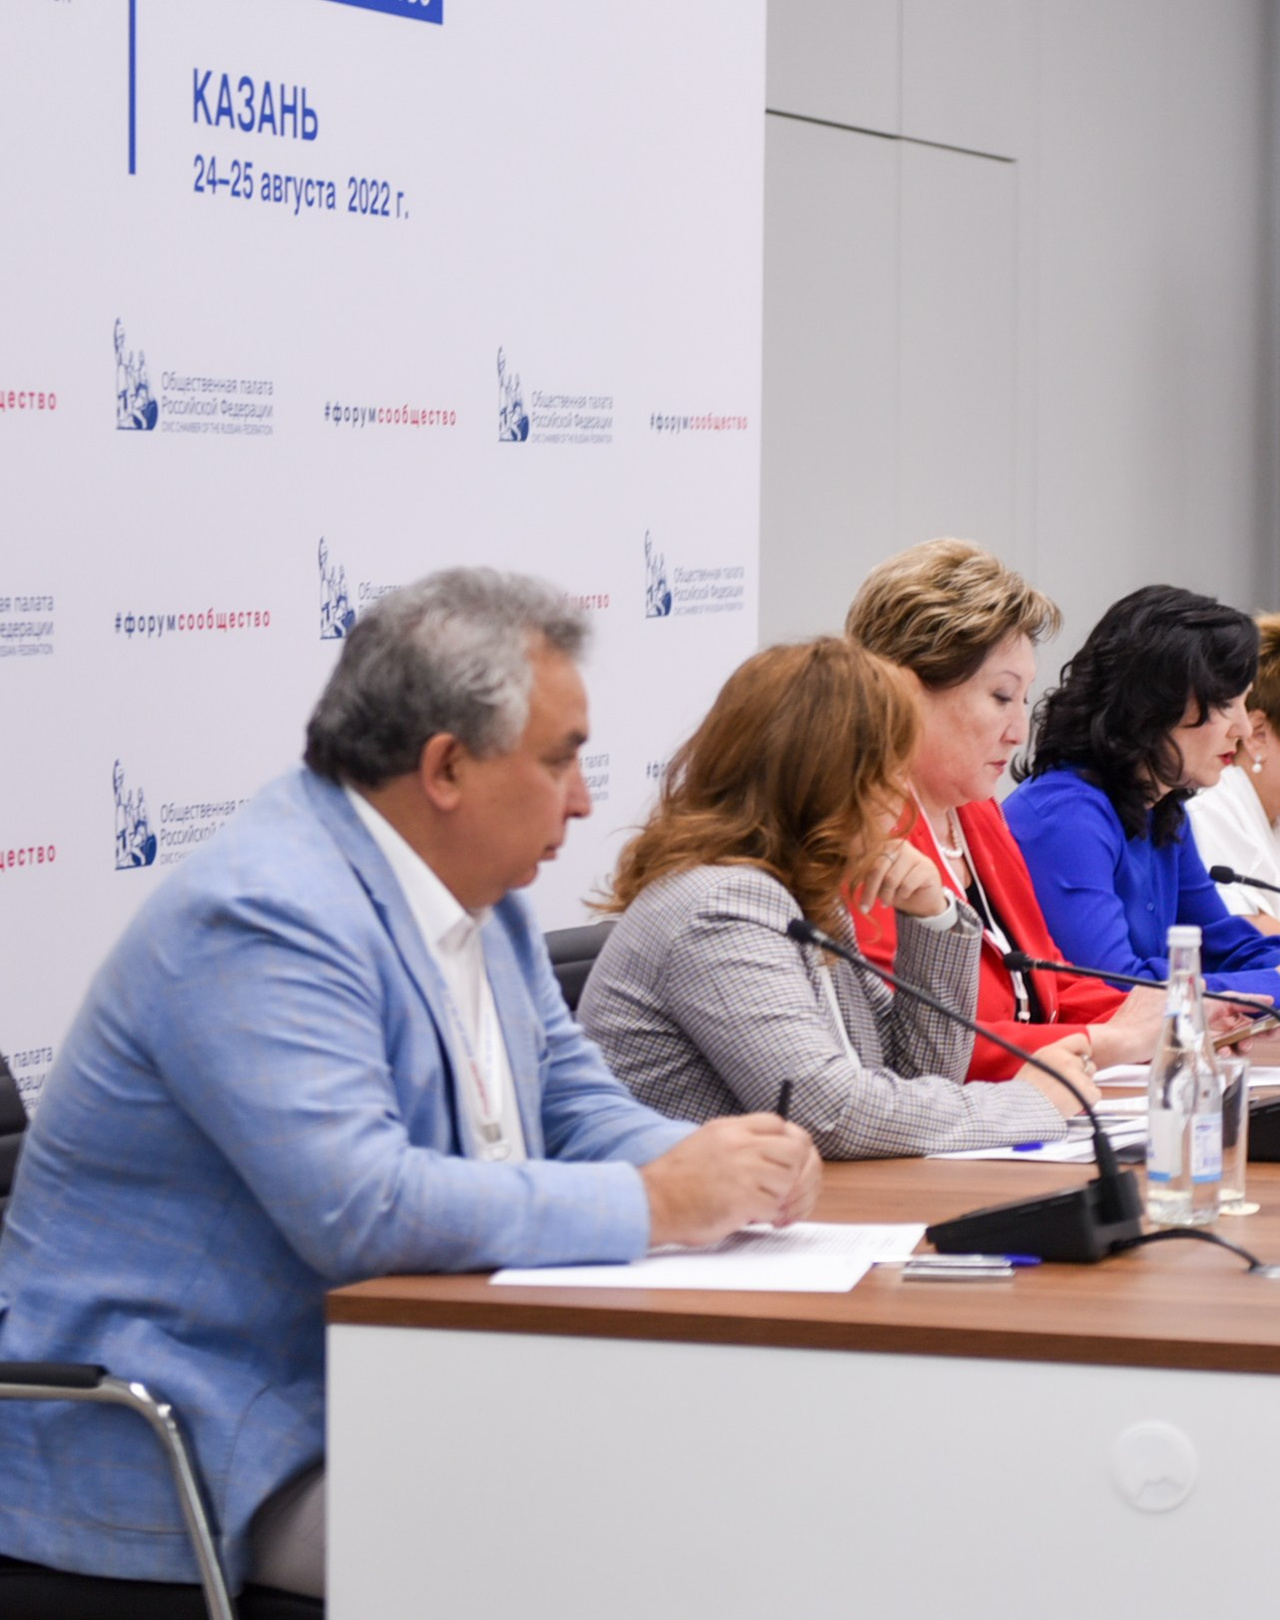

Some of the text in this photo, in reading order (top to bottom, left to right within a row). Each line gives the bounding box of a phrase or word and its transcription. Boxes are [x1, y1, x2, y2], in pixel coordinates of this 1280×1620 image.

[193, 68, 319, 141] КАЗАНЬ
[260, 172, 337, 216] августа
[347, 176, 391, 217] 2022
[396, 191, 410, 220] г.
[161, 371, 273, 396] Общественная палата
[161, 395, 273, 421] Российской Федерации
[324, 401, 457, 429] #форумсообщество
[650, 411, 748, 435] #форумсообщество
[14, 595, 54, 613] палата
[115, 608, 271, 639] #форумсообщество
[160, 800, 236, 825] Общественная
[13, 1045, 52, 1069] палата
